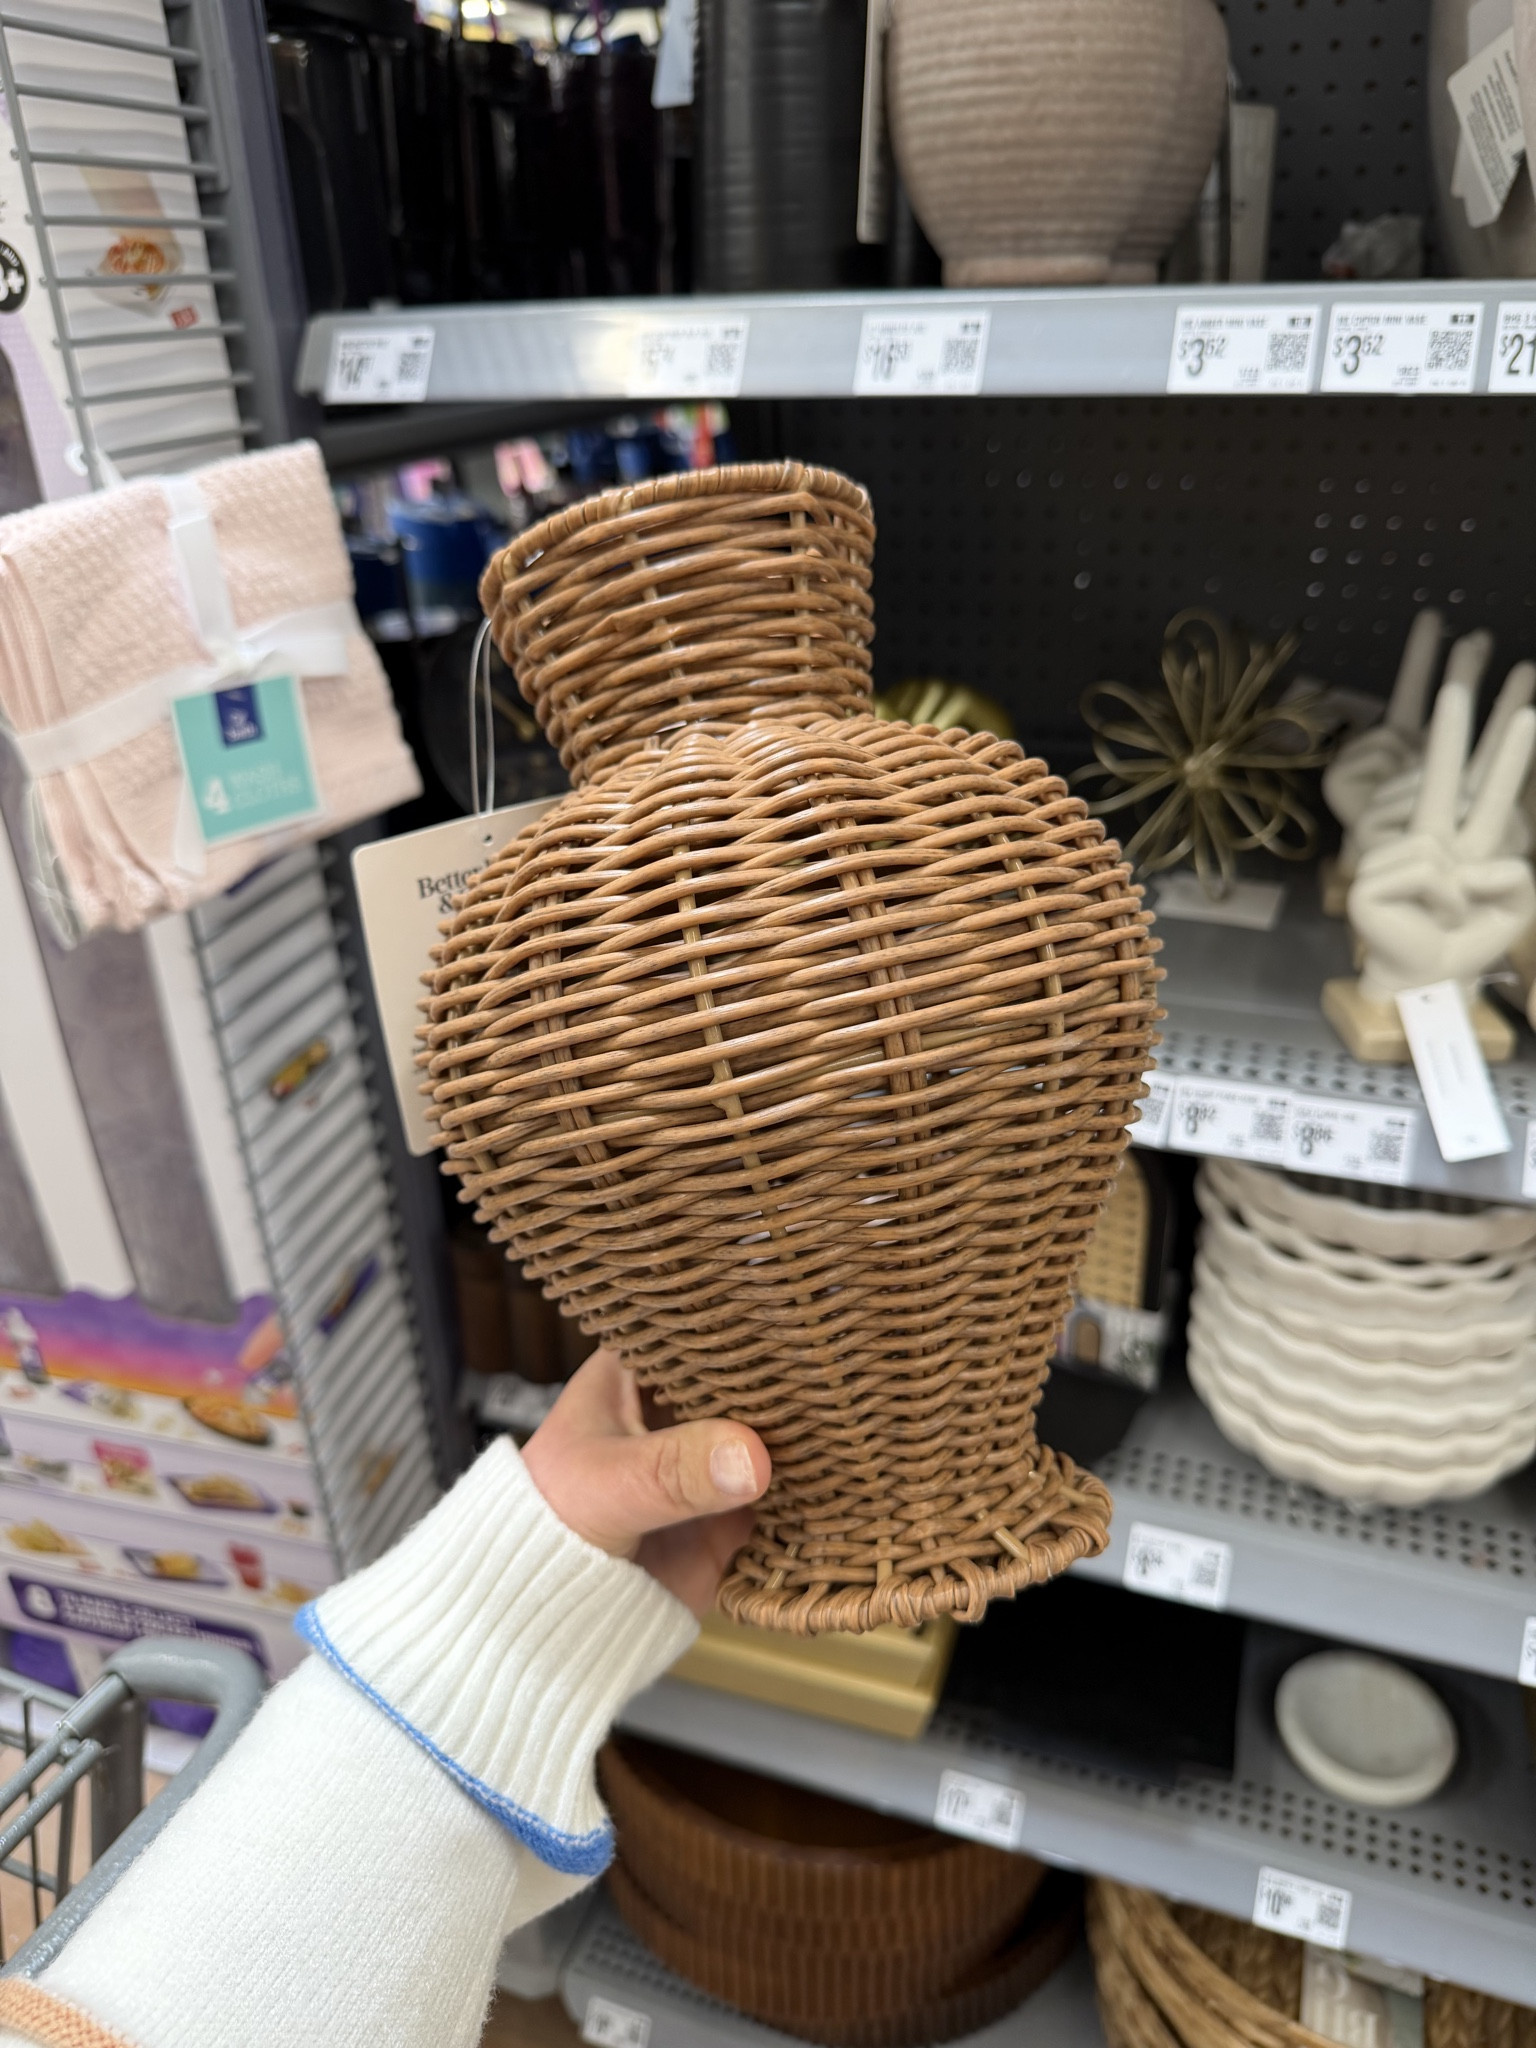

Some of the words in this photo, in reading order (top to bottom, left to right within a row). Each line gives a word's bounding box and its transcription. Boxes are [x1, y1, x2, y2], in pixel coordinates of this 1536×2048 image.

[204, 777, 231, 816] 4
[417, 866, 482, 899] Bette
[439, 892, 455, 915] &
